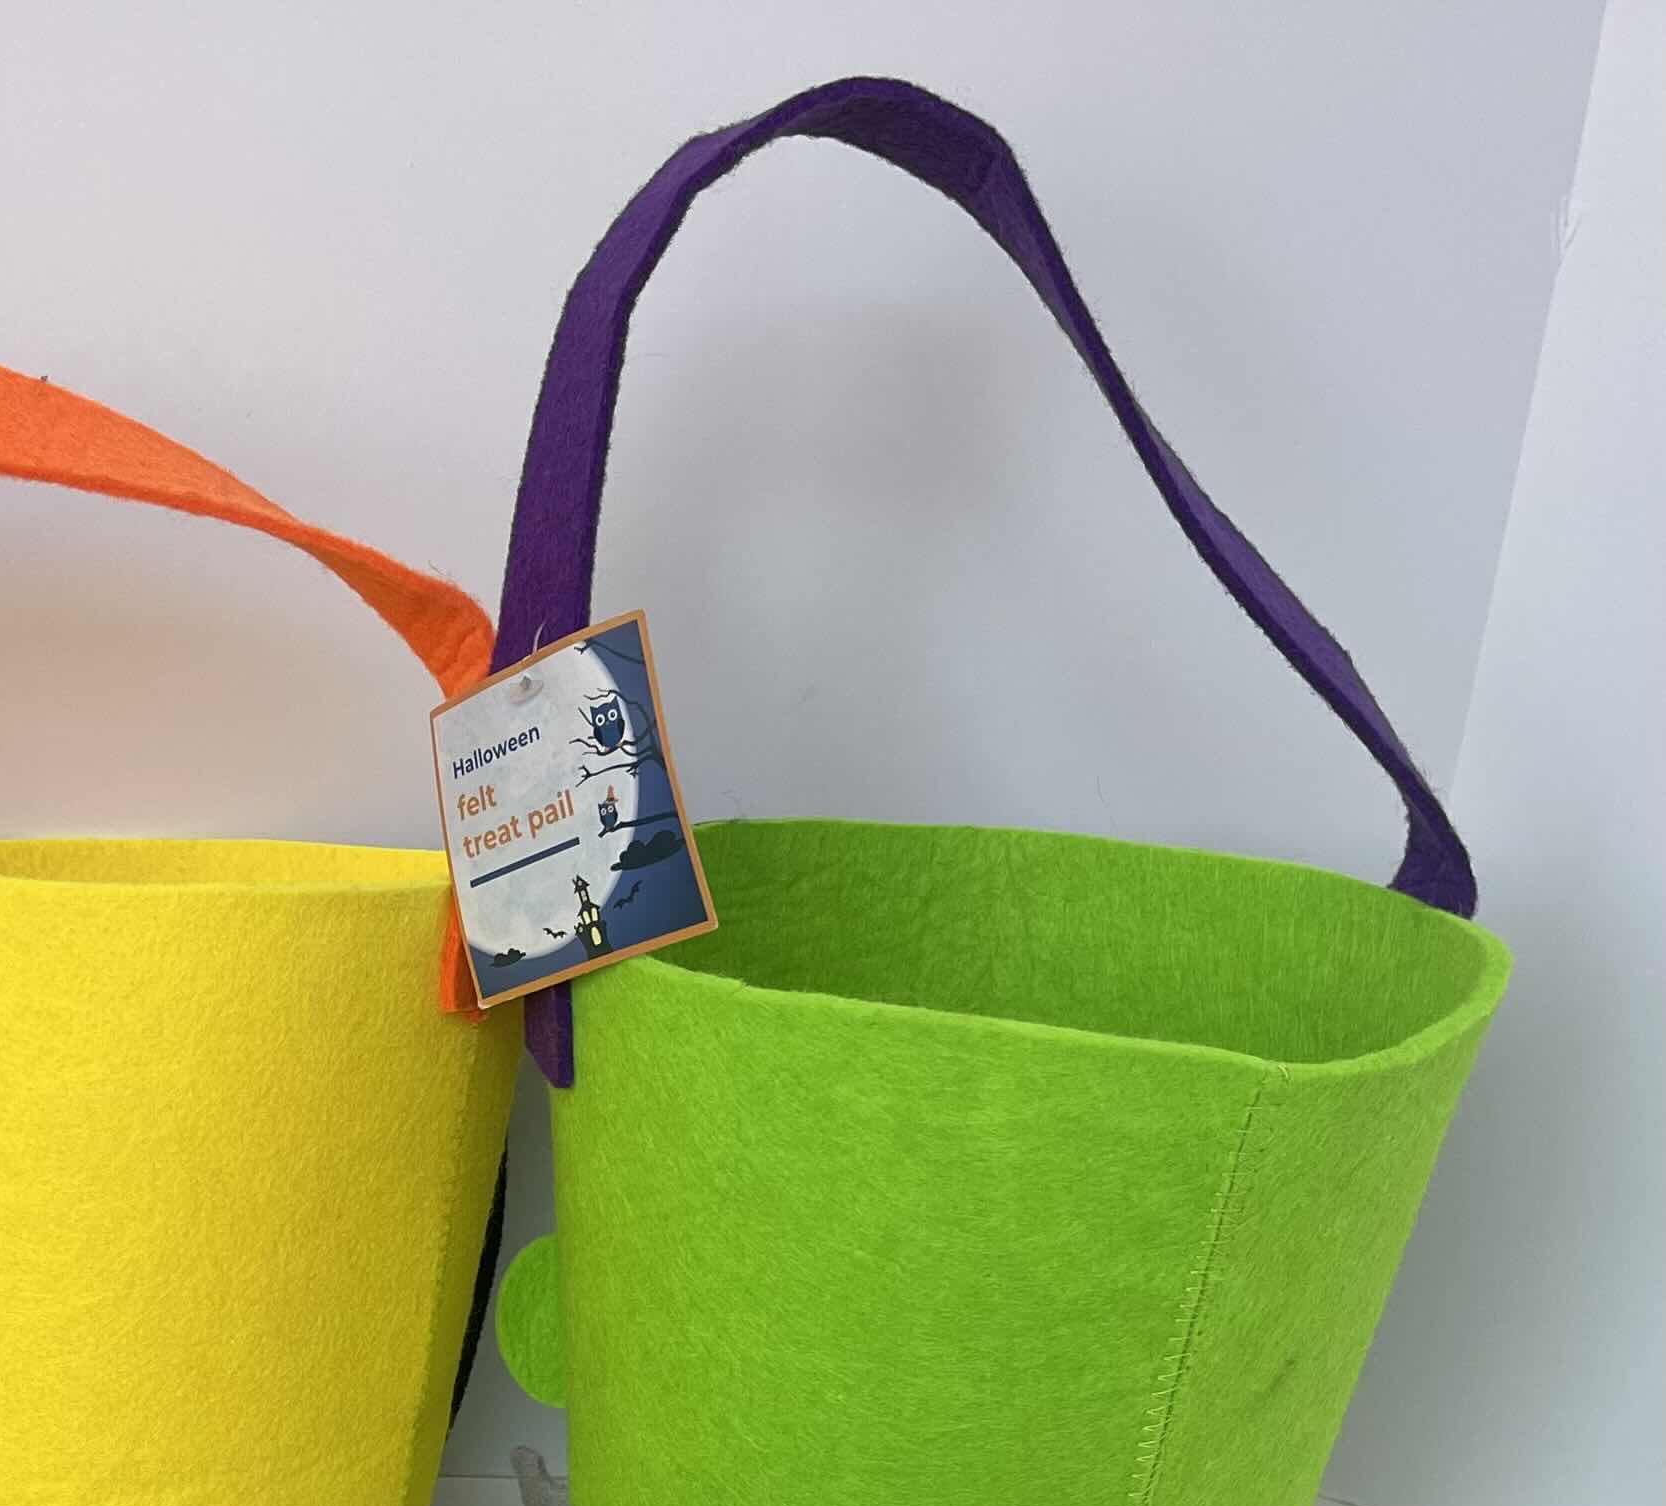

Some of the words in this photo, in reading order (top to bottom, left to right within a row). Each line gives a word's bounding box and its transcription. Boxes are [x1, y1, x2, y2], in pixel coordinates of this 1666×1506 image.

[453, 724, 541, 779] Halloween
[455, 785, 497, 821] felt
[462, 817, 523, 859] treat
[527, 789, 575, 837] pail
